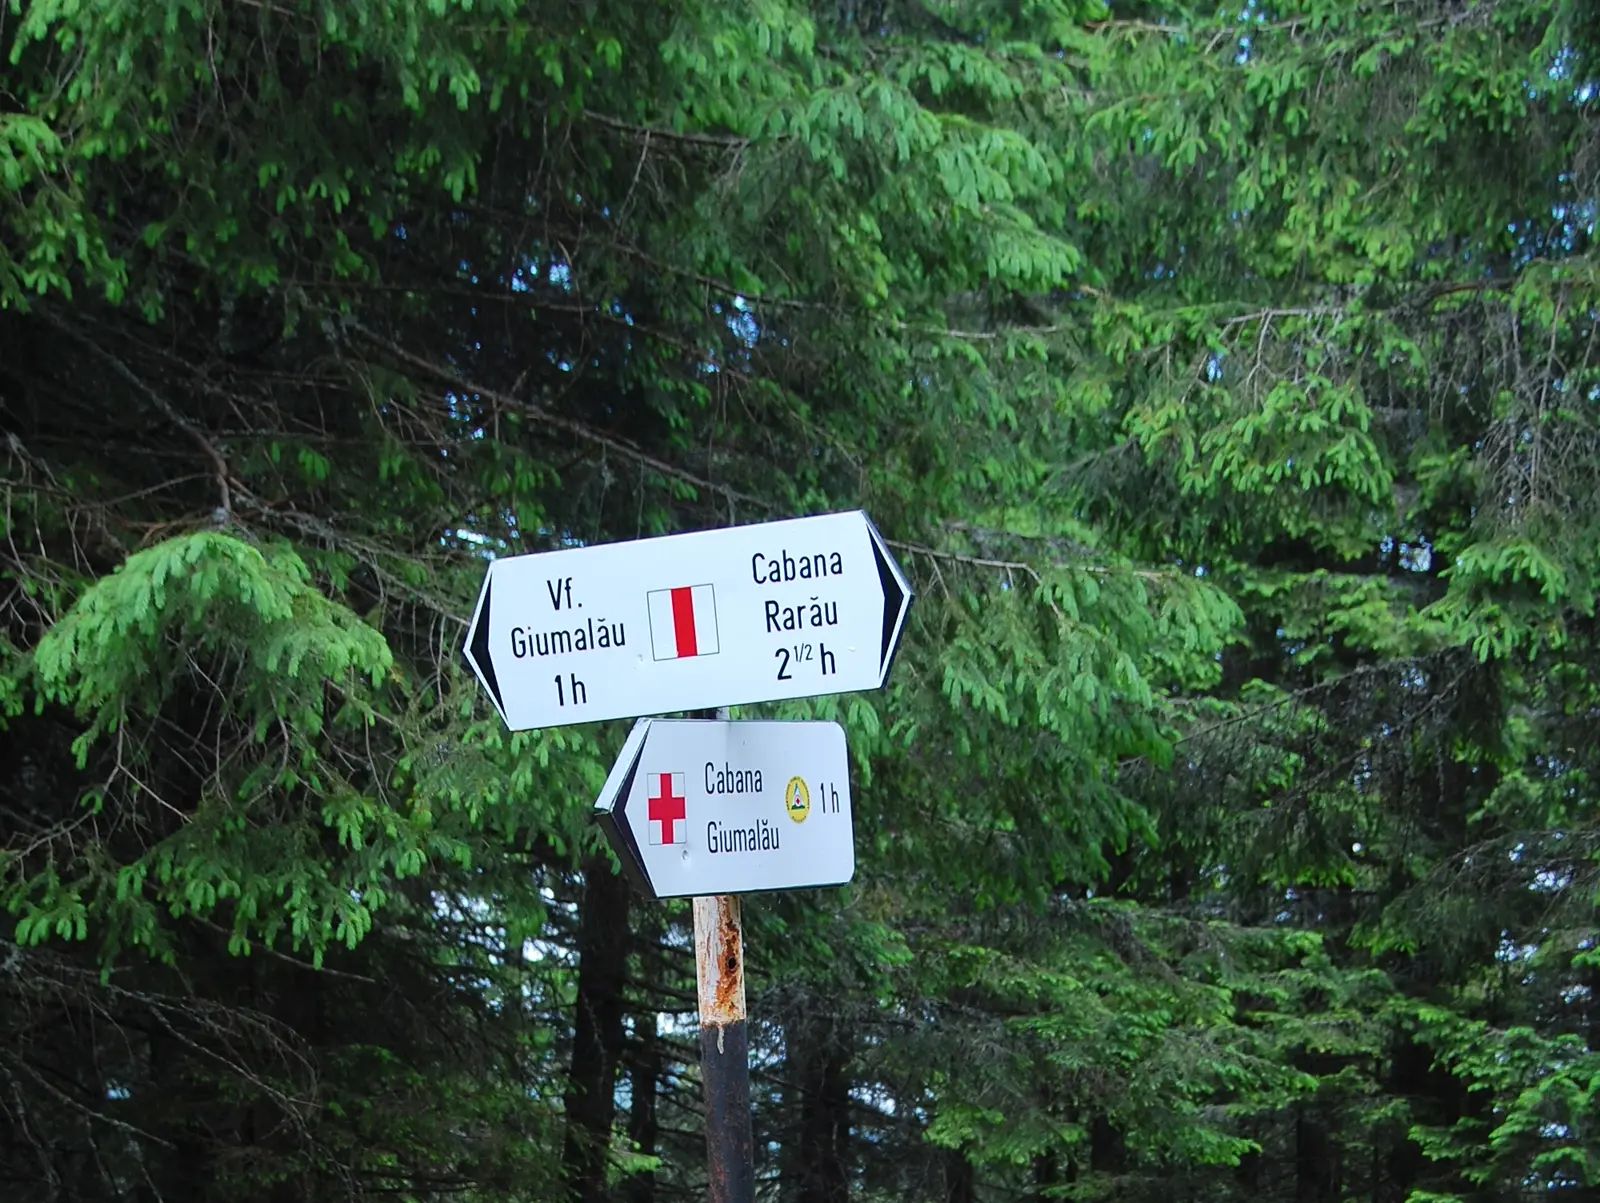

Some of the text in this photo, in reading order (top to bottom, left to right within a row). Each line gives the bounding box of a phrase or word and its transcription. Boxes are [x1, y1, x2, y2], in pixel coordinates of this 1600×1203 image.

[751, 549, 843, 585] Cabana
[546, 576, 584, 611] Vf.
[764, 596, 839, 633] Rarău
[510, 617, 627, 659] Giumalău
[704, 761, 763, 795] Cabana
[707, 818, 780, 854] Giumalău
